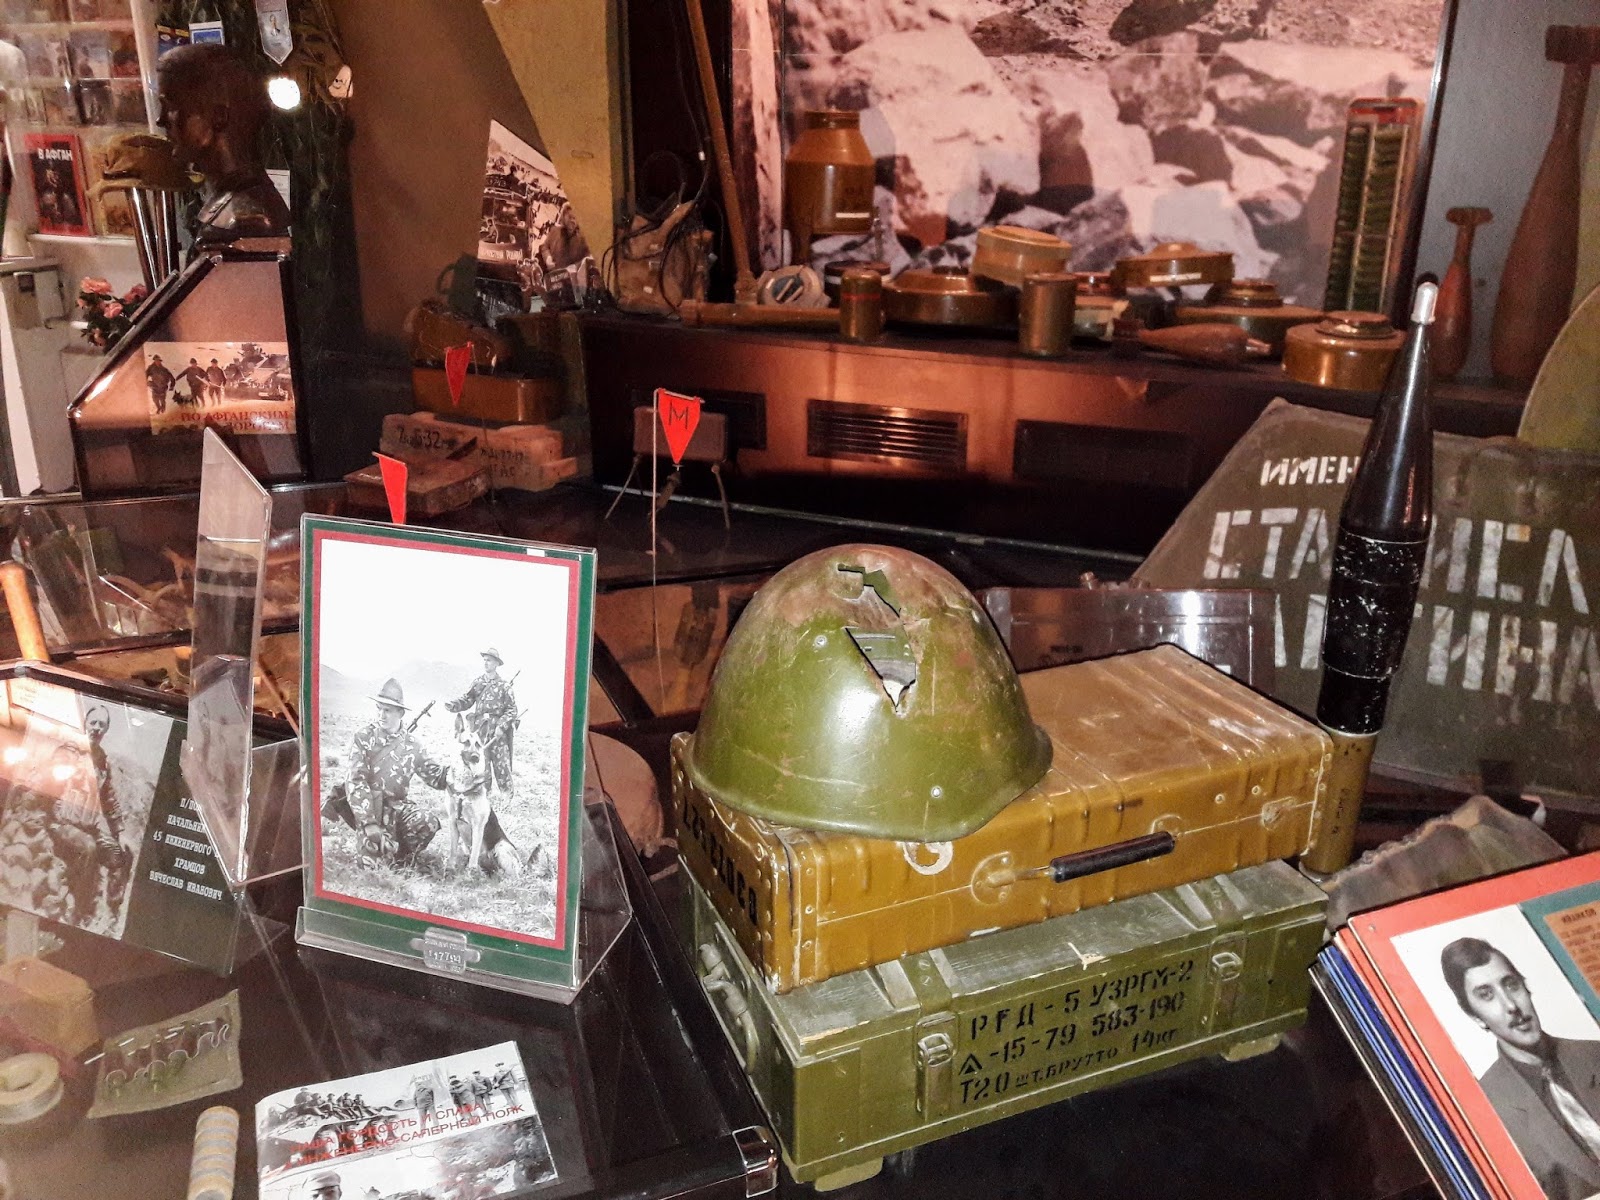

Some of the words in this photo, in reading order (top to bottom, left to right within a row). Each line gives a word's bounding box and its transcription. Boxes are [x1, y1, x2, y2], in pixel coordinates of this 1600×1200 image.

[153, 830, 163, 842] 45
[165, 834, 212, 856] ИНЖЕНЕРНОГО
[149, 870, 184, 890] ВЯЧЕСЛАВ
[186, 881, 223, 901] ИВАНОВИЧ
[484, 1103, 525, 1123] ПОЛК
